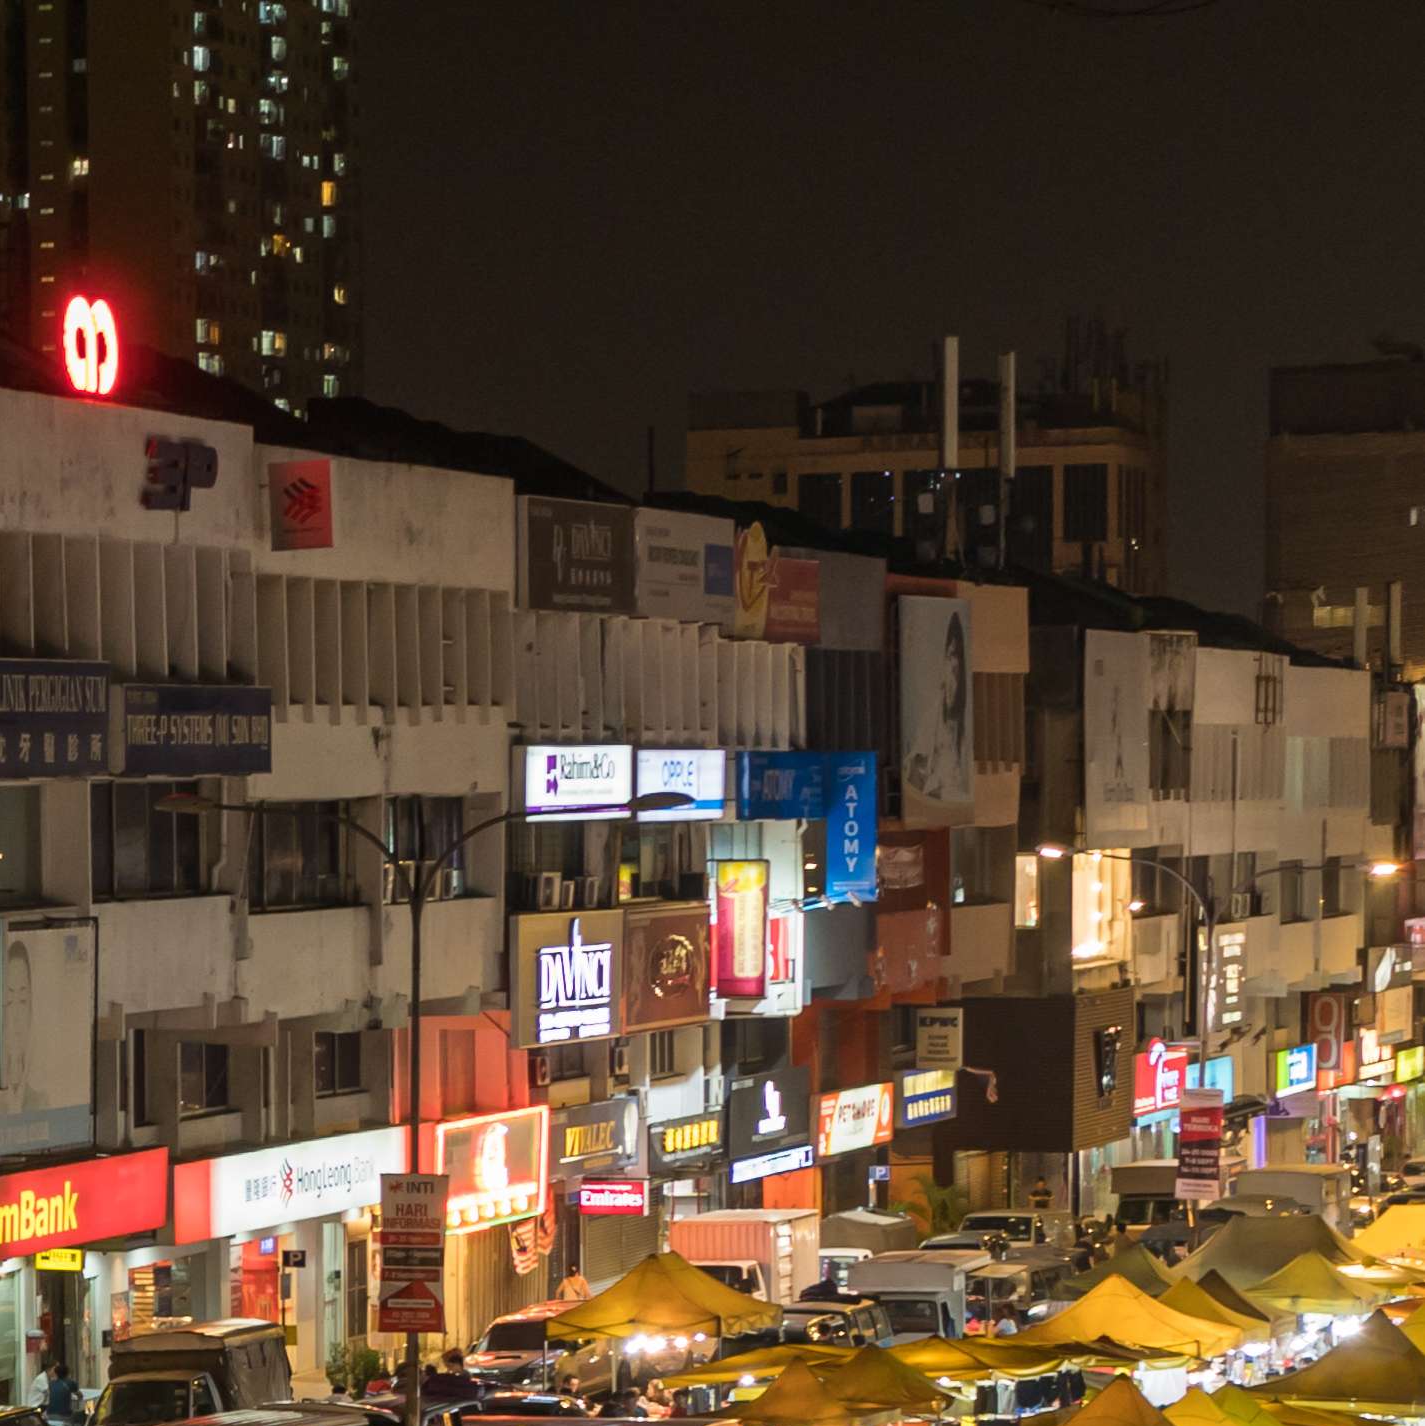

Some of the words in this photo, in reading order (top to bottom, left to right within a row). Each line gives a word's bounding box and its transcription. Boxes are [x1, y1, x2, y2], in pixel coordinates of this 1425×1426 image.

[843, 783, 859, 873] ATOMY
[406, 1181, 435, 1195] INTI
[580, 1190, 643, 1208] Emirates
[396, 1203, 428, 1217] HARI
